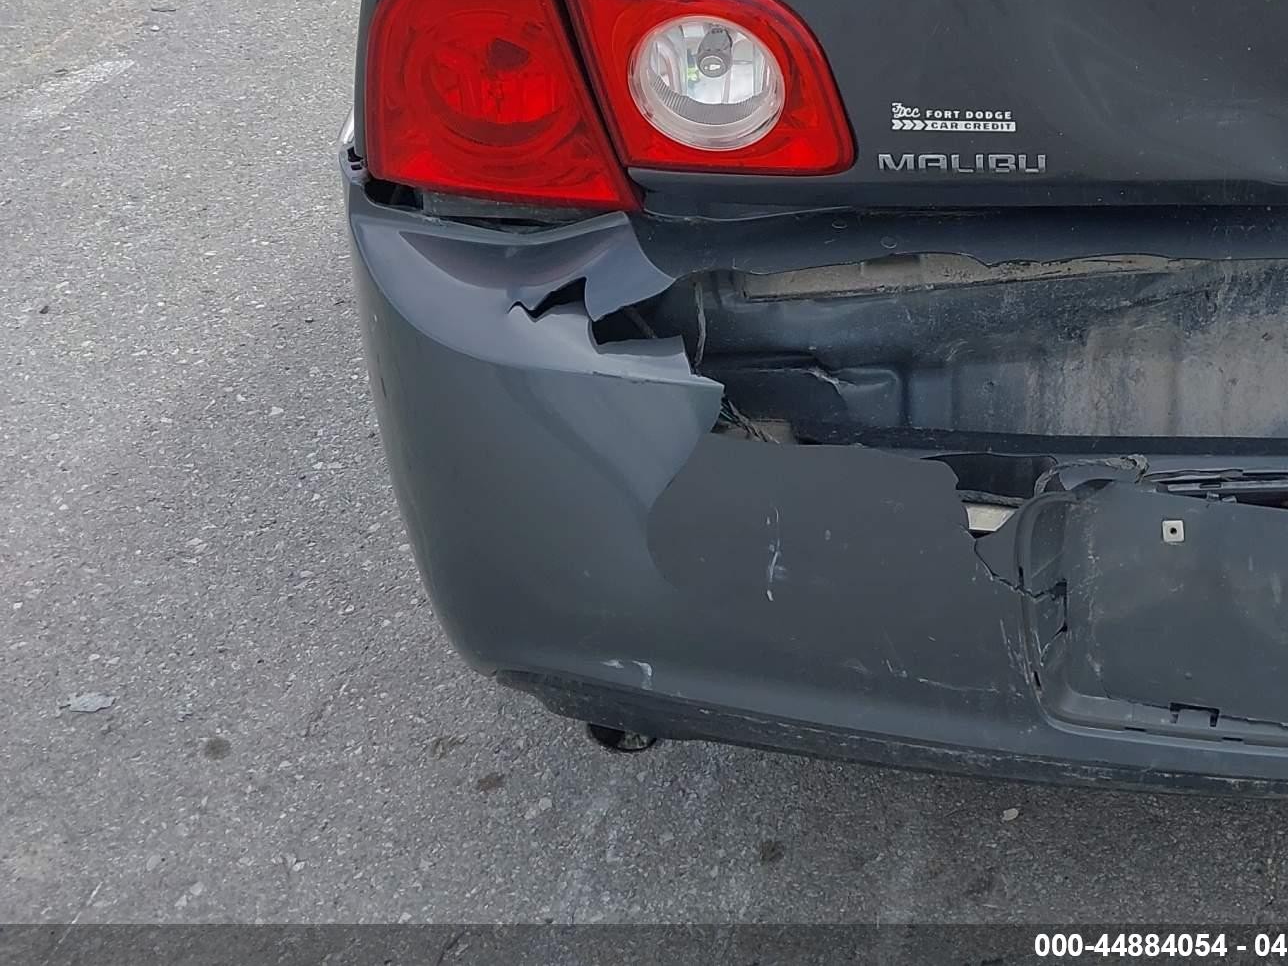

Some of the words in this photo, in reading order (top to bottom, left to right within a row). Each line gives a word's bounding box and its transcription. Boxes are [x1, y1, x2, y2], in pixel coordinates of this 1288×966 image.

[926, 110, 960, 119] FORT
[965, 111, 1012, 120] DODGE
[931, 121, 959, 130] CAR
[964, 122, 1012, 131] CREDIT
[878, 153, 1047, 173] MALIBU
